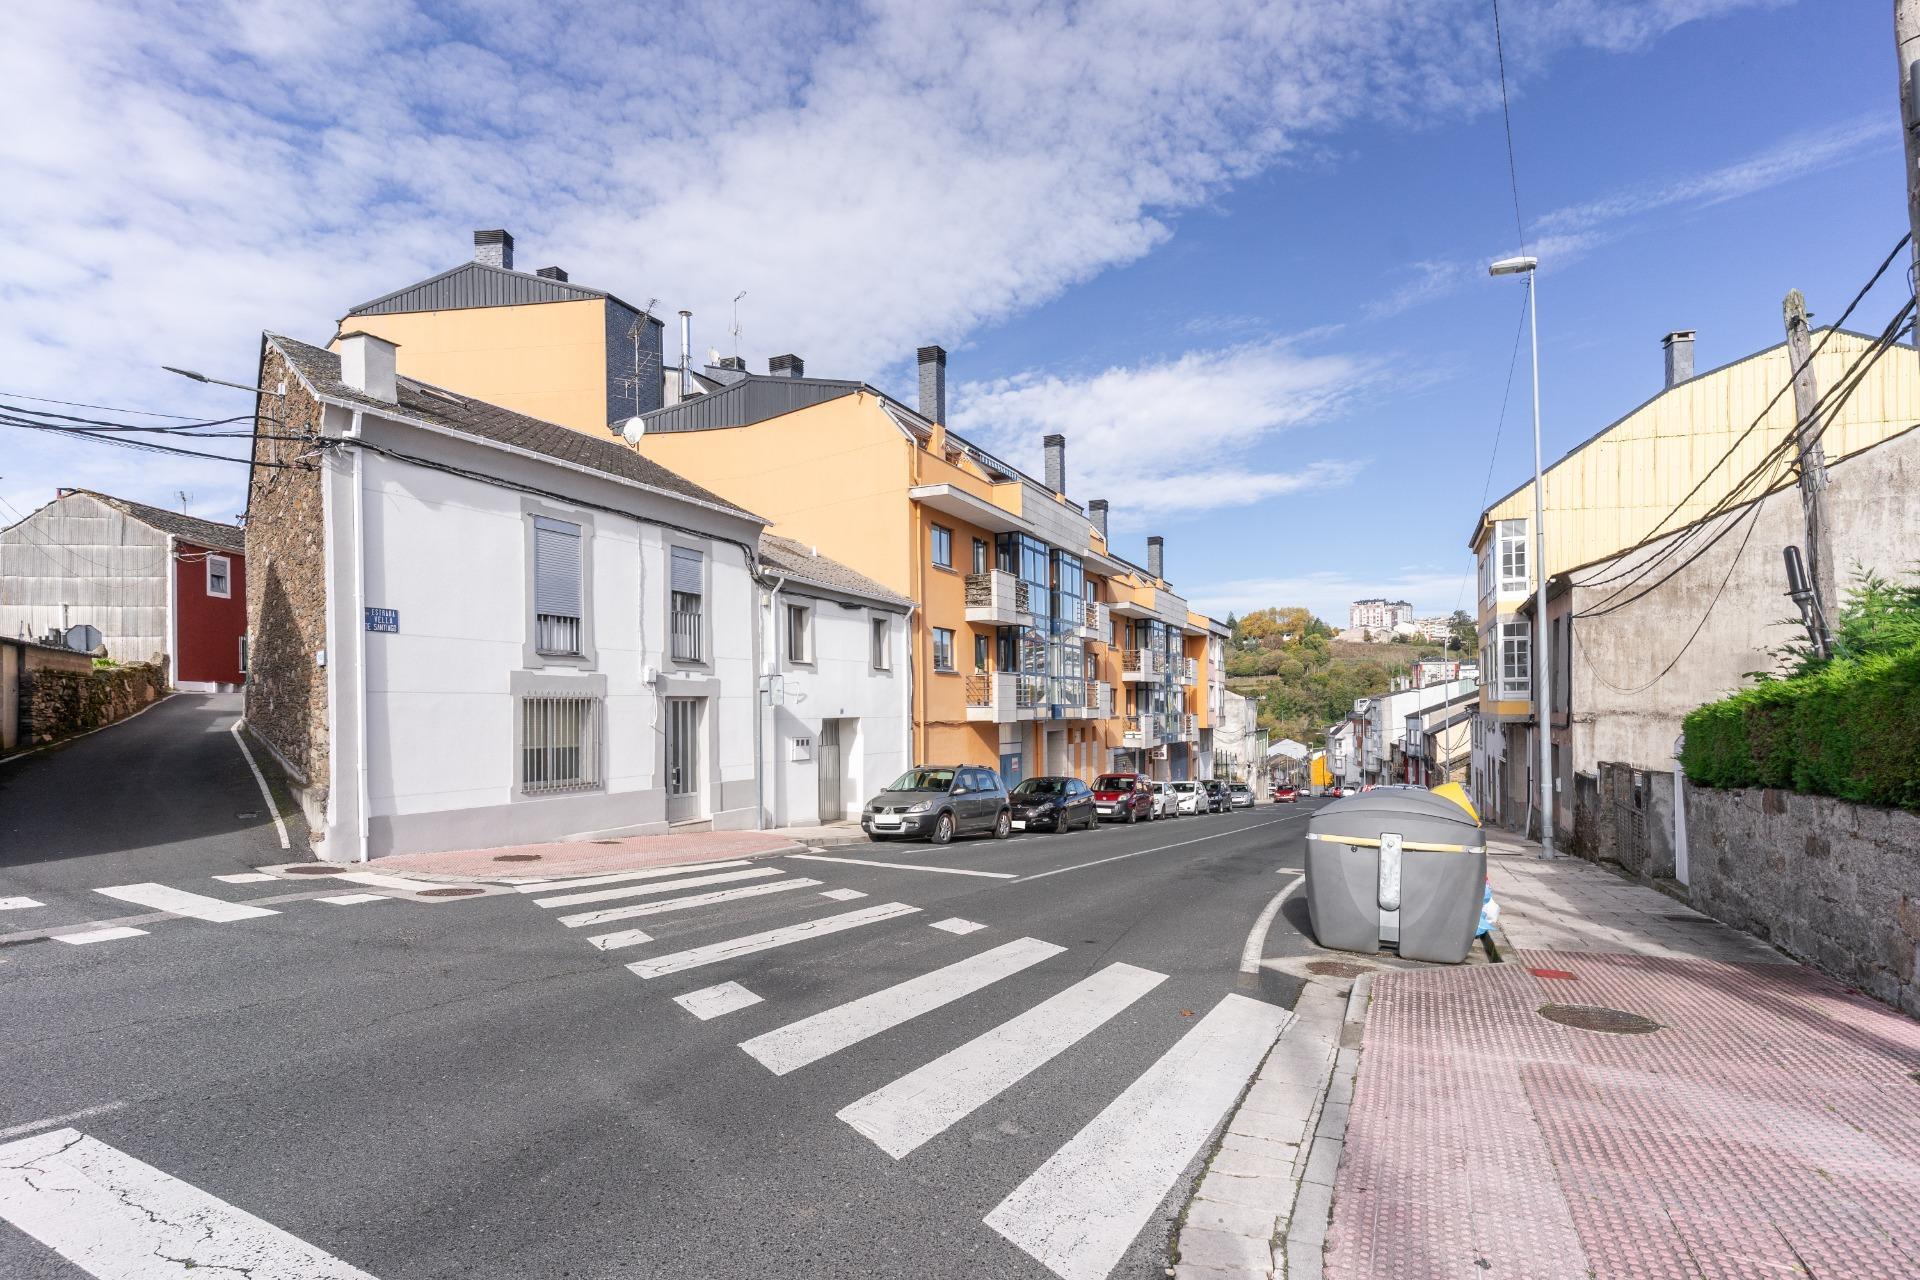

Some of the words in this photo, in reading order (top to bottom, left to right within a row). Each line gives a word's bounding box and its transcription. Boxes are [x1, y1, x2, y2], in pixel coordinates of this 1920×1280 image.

[372, 608, 395, 617] ESTRADA
[374, 616, 393, 624] VELLA
[374, 624, 397, 632] SANTIAGO
